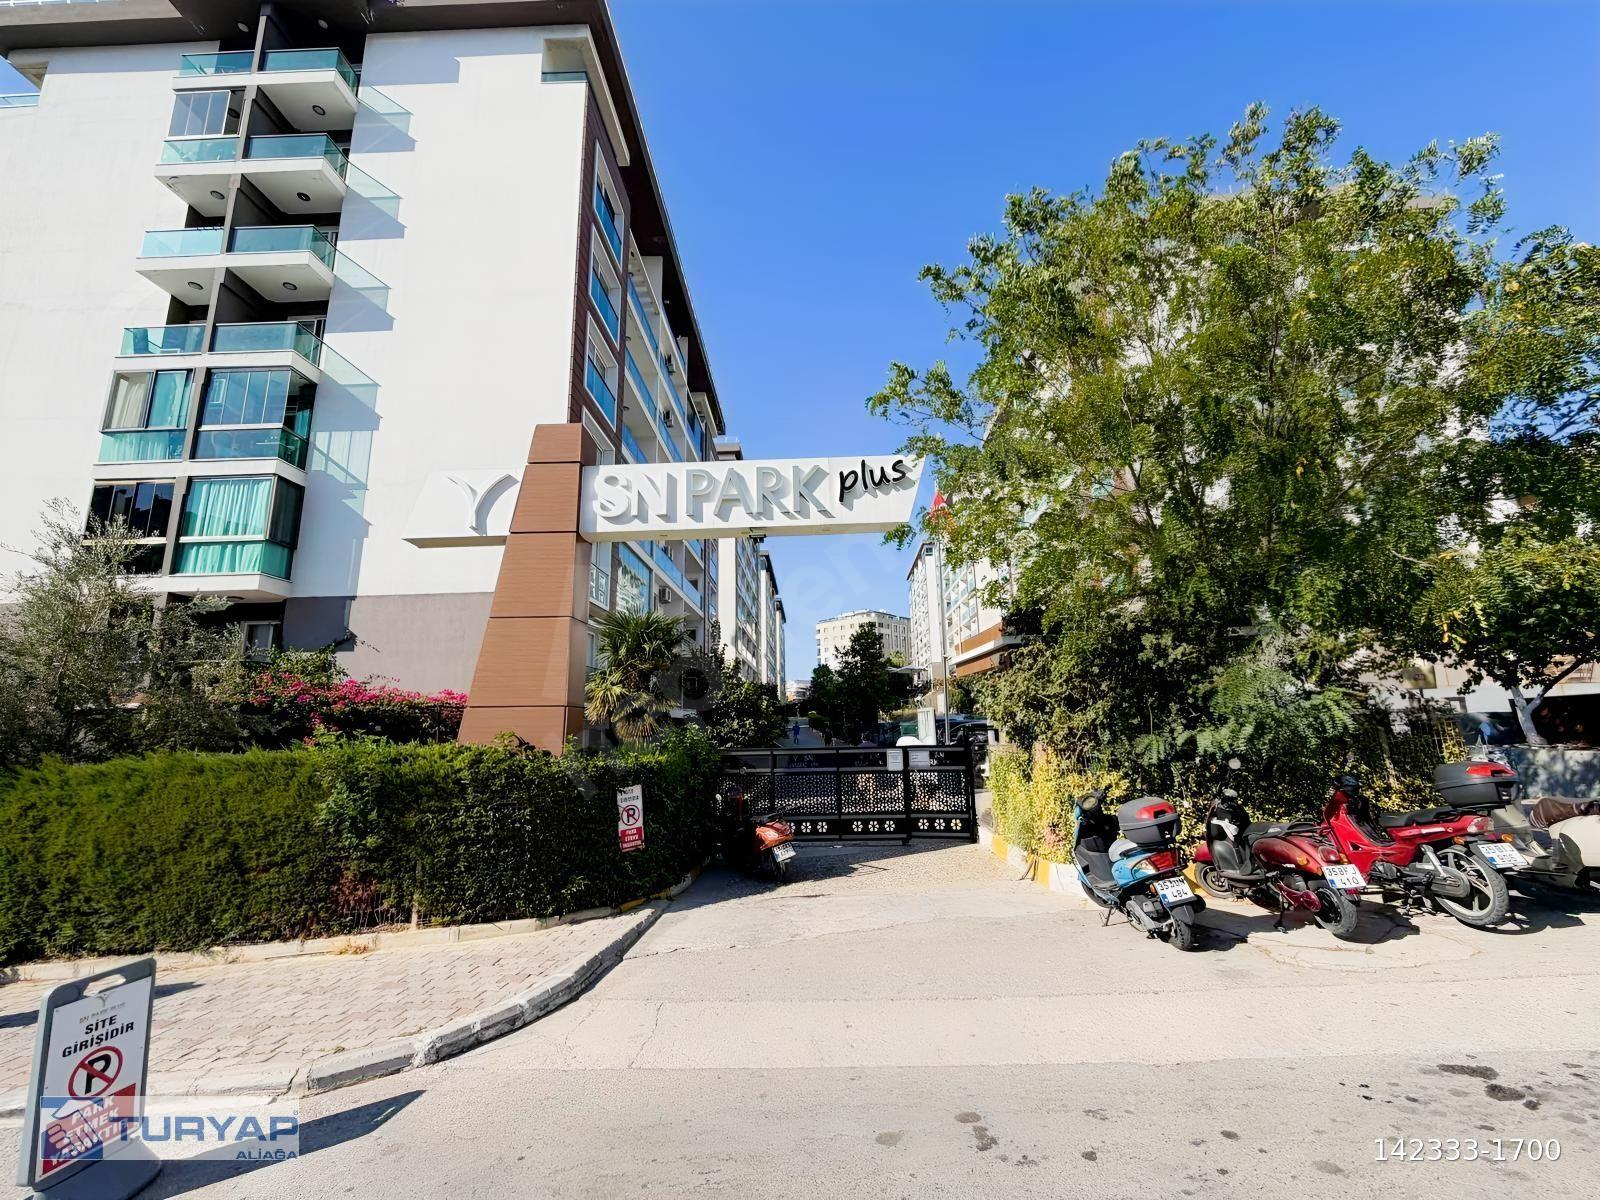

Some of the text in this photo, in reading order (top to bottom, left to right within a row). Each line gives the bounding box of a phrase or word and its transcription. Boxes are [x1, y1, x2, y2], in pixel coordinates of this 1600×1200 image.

[593, 458, 907, 518] SN PARK plus
[62, 1021, 135, 1058] GİRİŞİDİR
[84, 1014, 118, 1035] SİTE
